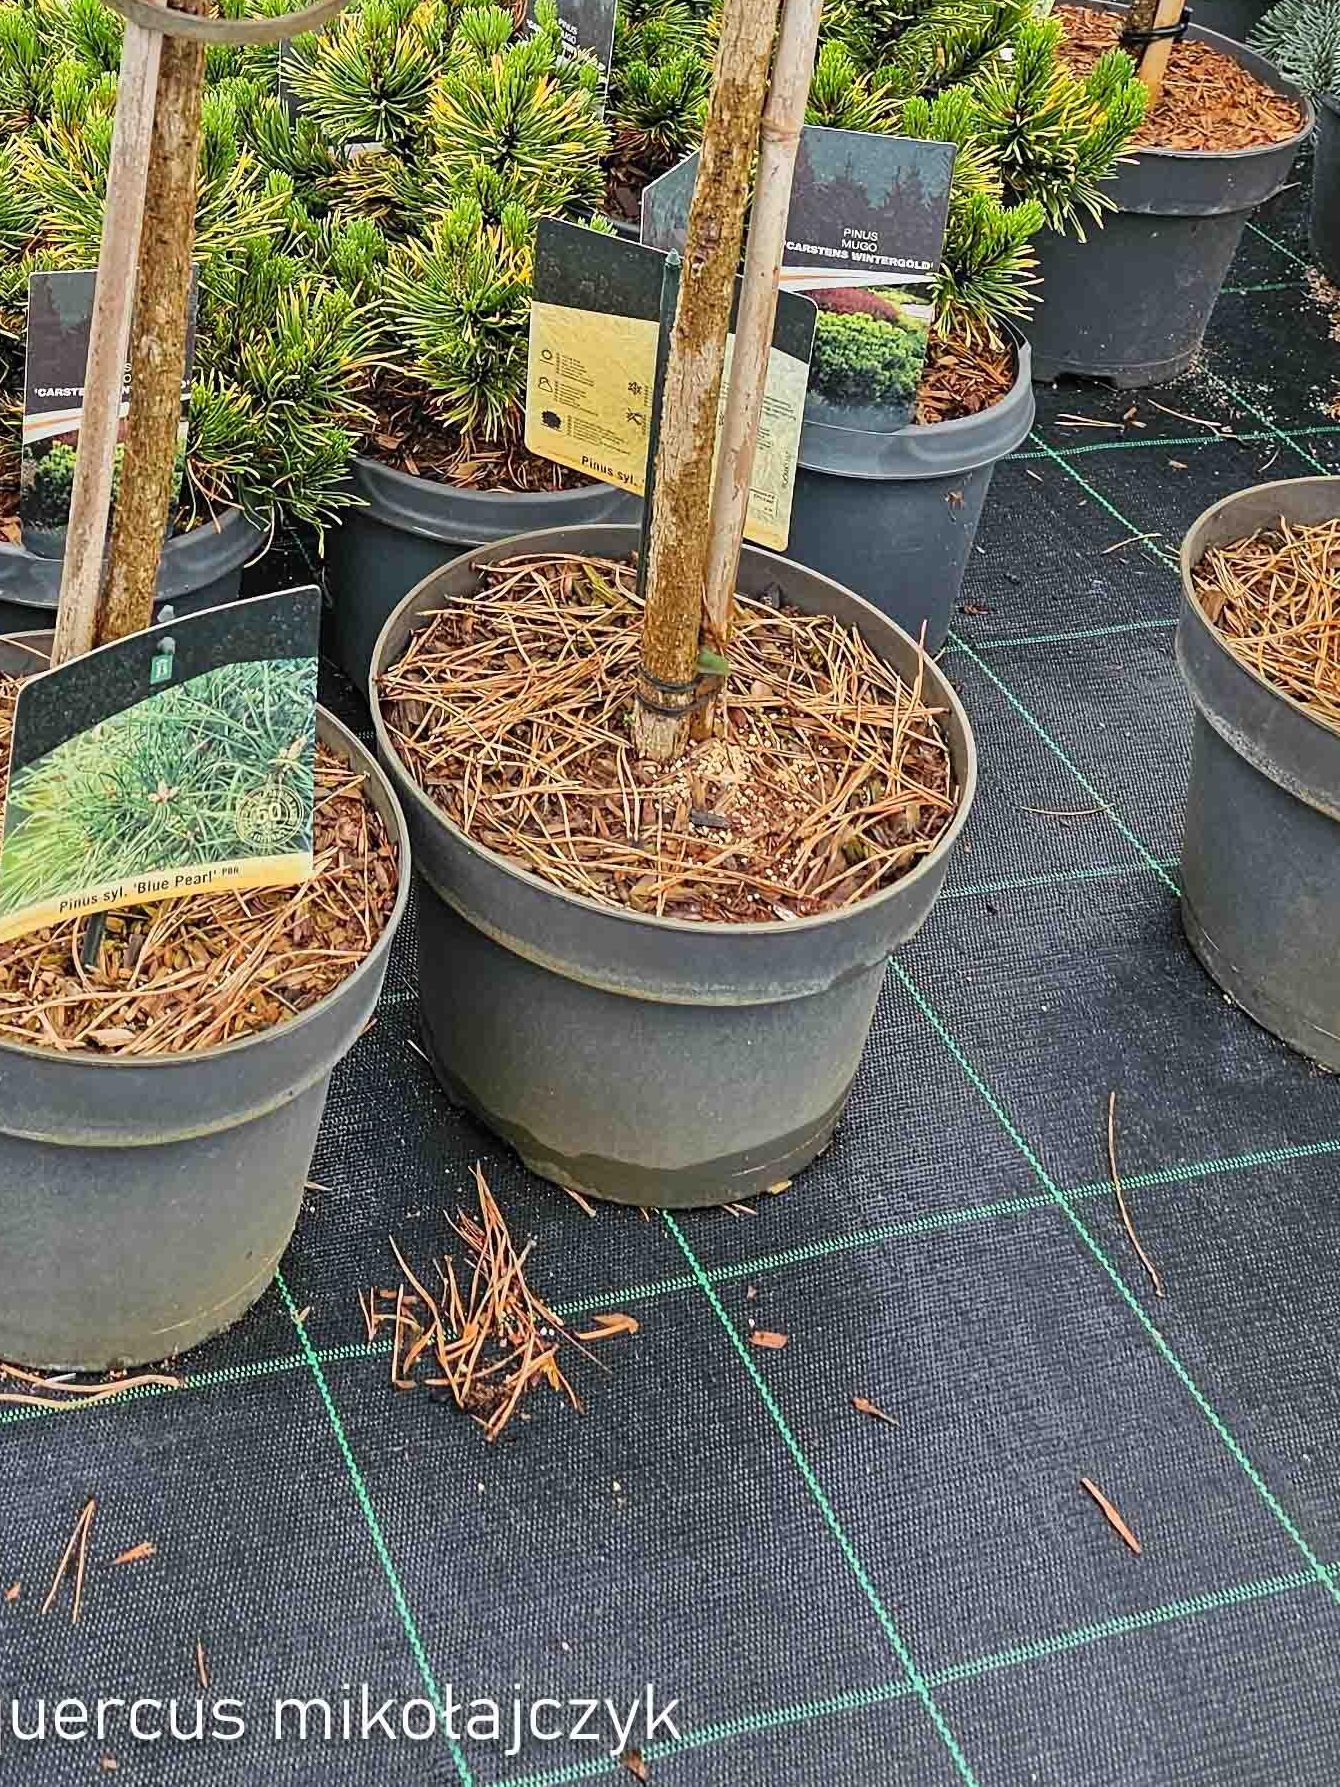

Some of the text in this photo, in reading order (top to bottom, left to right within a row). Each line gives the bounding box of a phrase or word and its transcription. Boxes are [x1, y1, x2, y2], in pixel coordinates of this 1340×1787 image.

[843, 228, 878, 242] PINUS
[841, 239, 878, 253] MUGO
[851, 251, 934, 271] WINTERGOLD'
[35, 387, 84, 398] 'CARSTE
[581, 455, 614, 477] Pinus
[59, 894, 98, 913] Pinus
[103, 885, 128, 903] syl.
[133, 877, 169, 895] 'Blue
[174, 869, 218, 888] Pearl'
